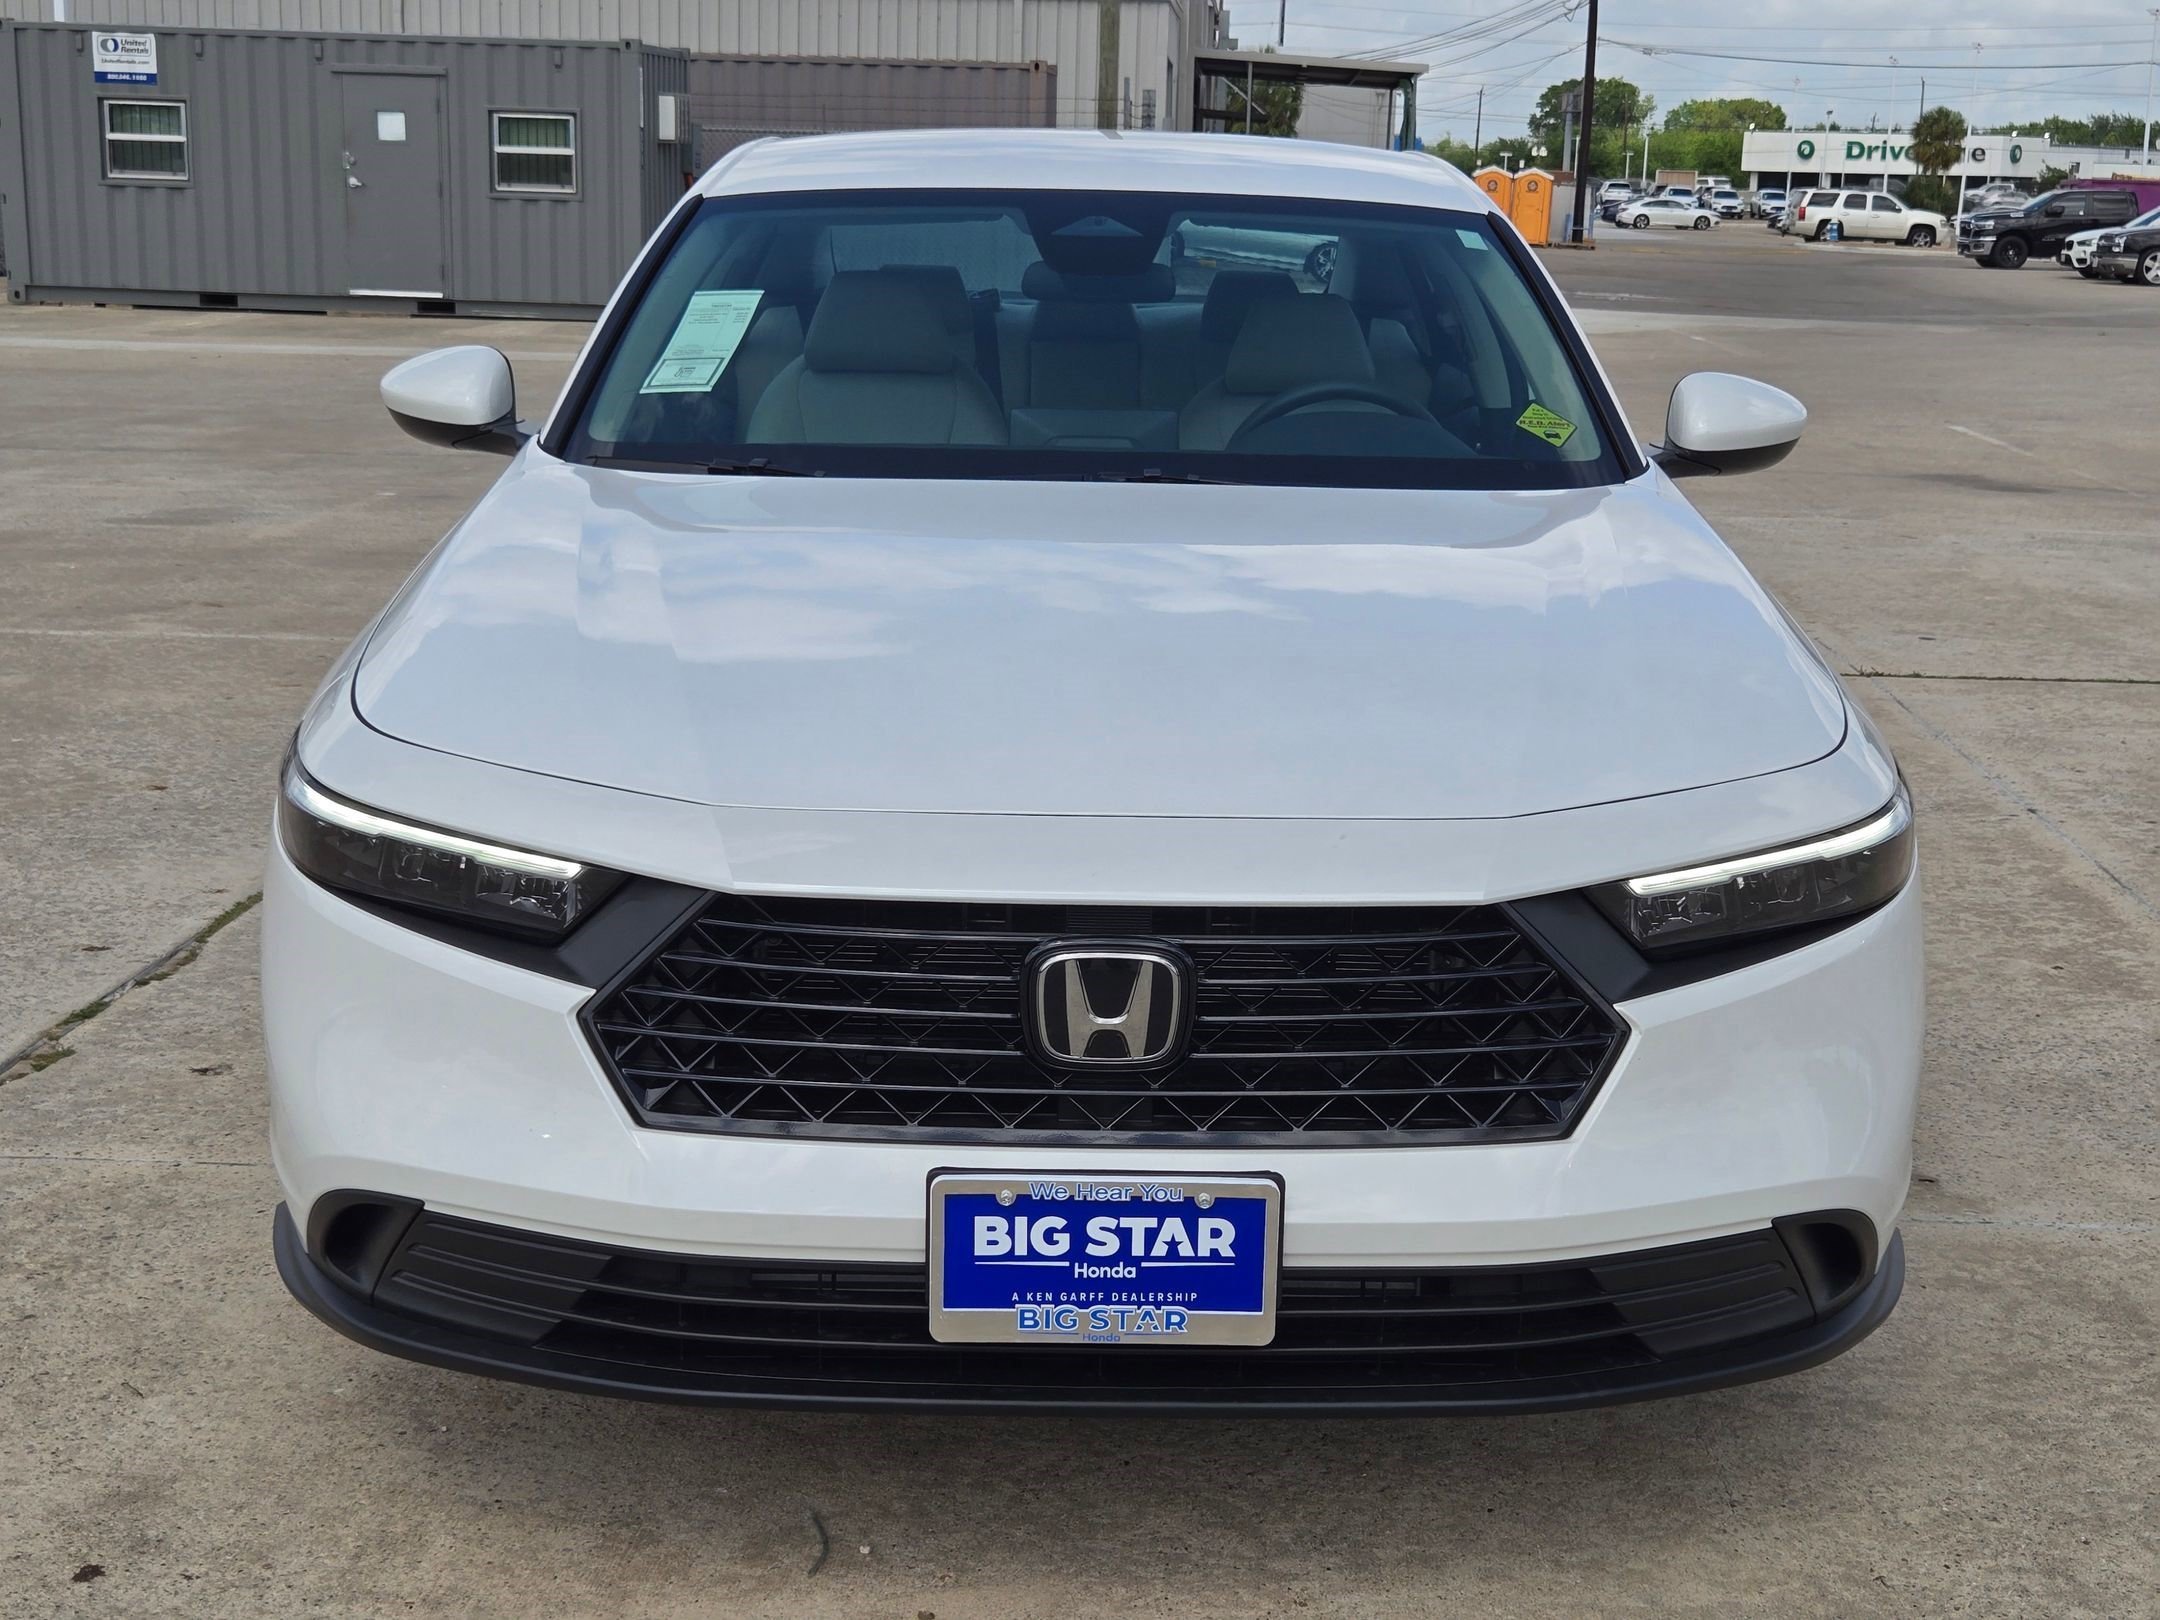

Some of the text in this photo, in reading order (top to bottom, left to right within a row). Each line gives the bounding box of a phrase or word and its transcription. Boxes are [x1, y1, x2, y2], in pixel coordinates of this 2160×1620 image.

[120, 46, 149, 54] Rentals
[1029, 1182, 1184, 1202] We Hear You
[974, 1215, 1236, 1258] BIG STAR
[1074, 1261, 1137, 1279] Honda
[1011, 1292, 1198, 1302] A KEN GARFF DEALERSHIP
[1016, 1306, 1188, 1333] BIG STAR
[1082, 1333, 1121, 1343] Honda
